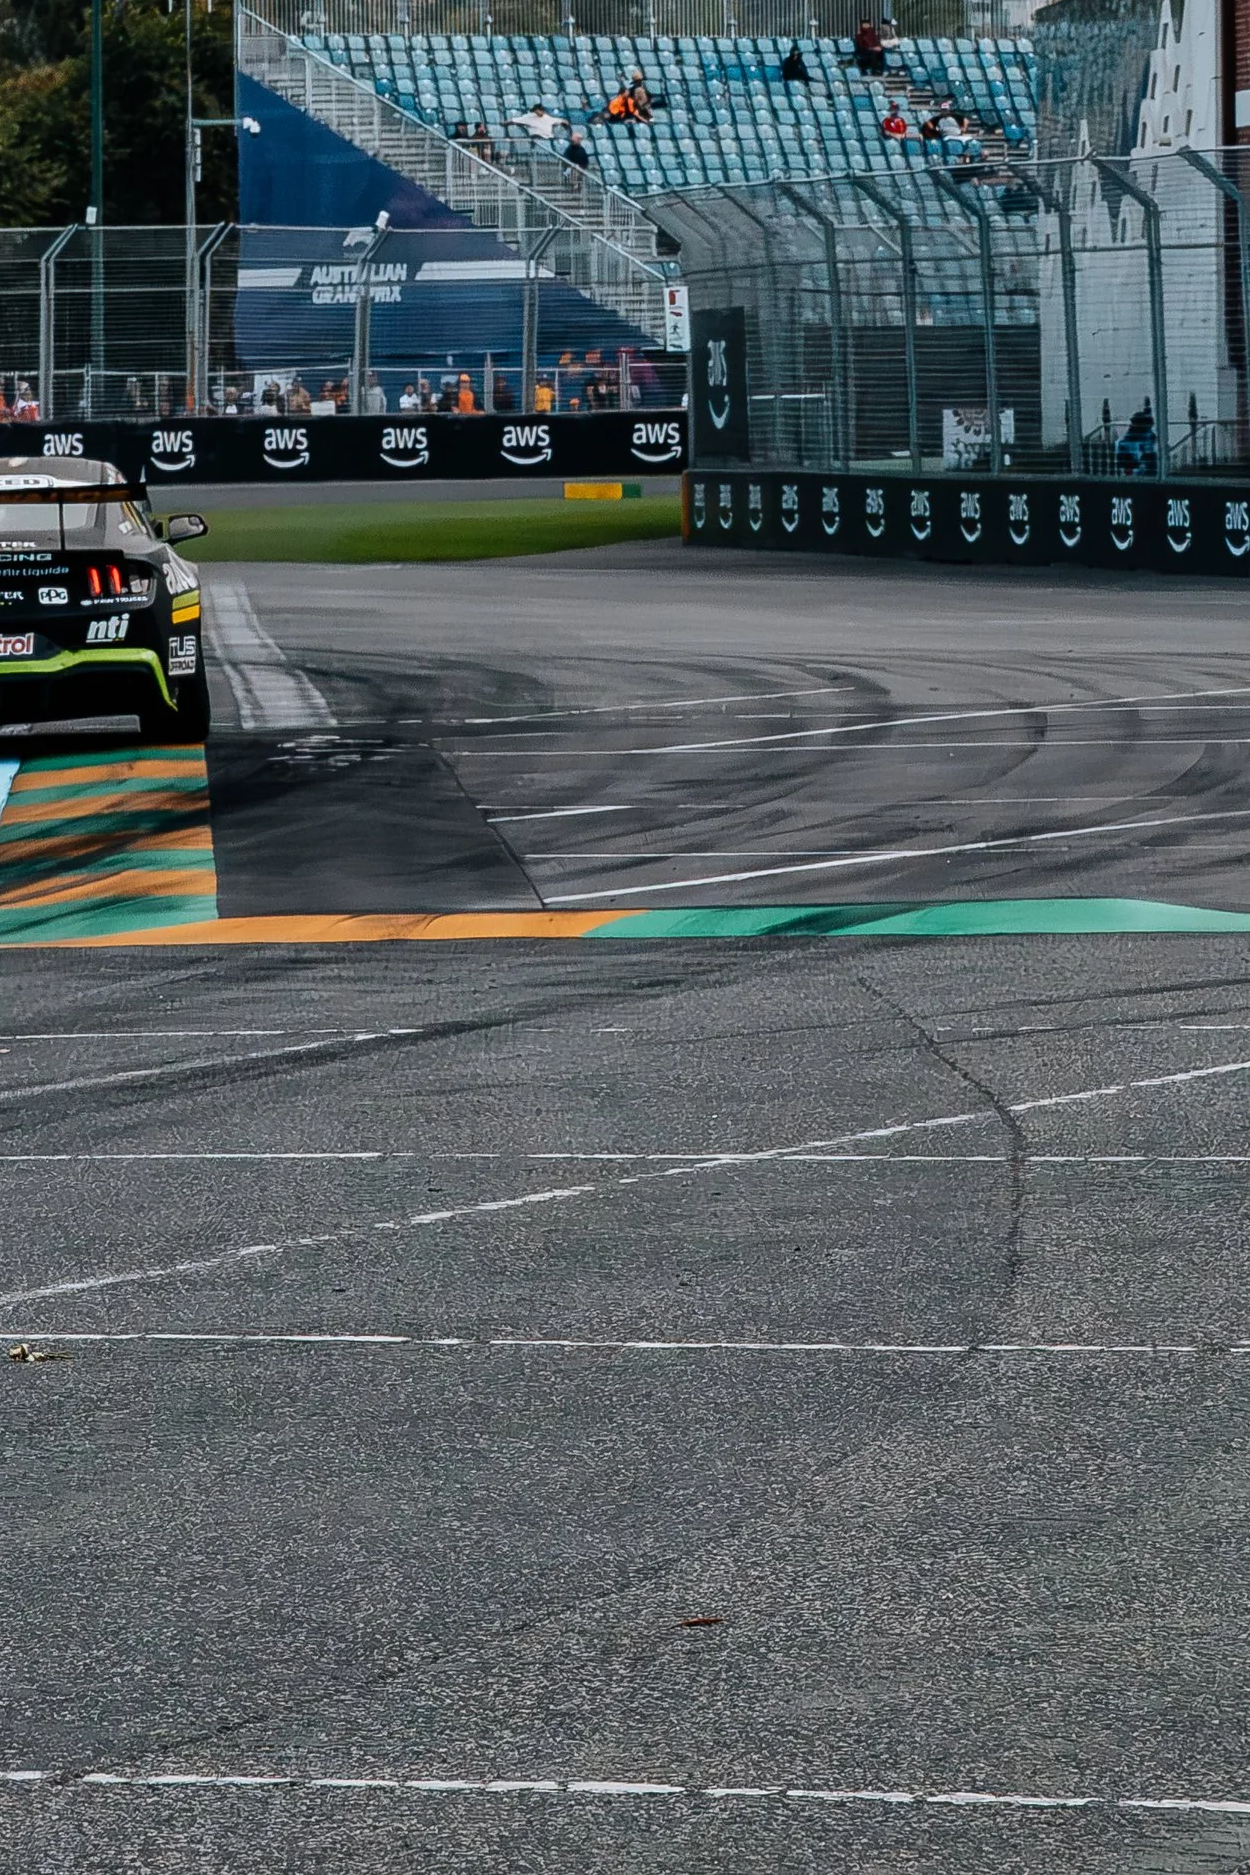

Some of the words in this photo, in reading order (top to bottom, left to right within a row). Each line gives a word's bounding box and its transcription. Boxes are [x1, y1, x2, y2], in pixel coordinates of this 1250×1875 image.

[310, 263, 408, 285] AUSTRLIAN
[312, 285, 368, 304] GRAN
[43, 433, 84, 456] aws
[151, 429, 194, 454] aws
[264, 428, 309, 451] aws
[381, 427, 428, 450] aws
[502, 425, 550, 447] aws
[632, 423, 681, 445] aws
[1059, 494, 1081, 523] aws
[1111, 496, 1133, 526] aws
[1167, 499, 1191, 527] aws
[1225, 501, 1250, 531] aws
[40, 588, 67, 602] PPG
[86, 613, 130, 639] nti
